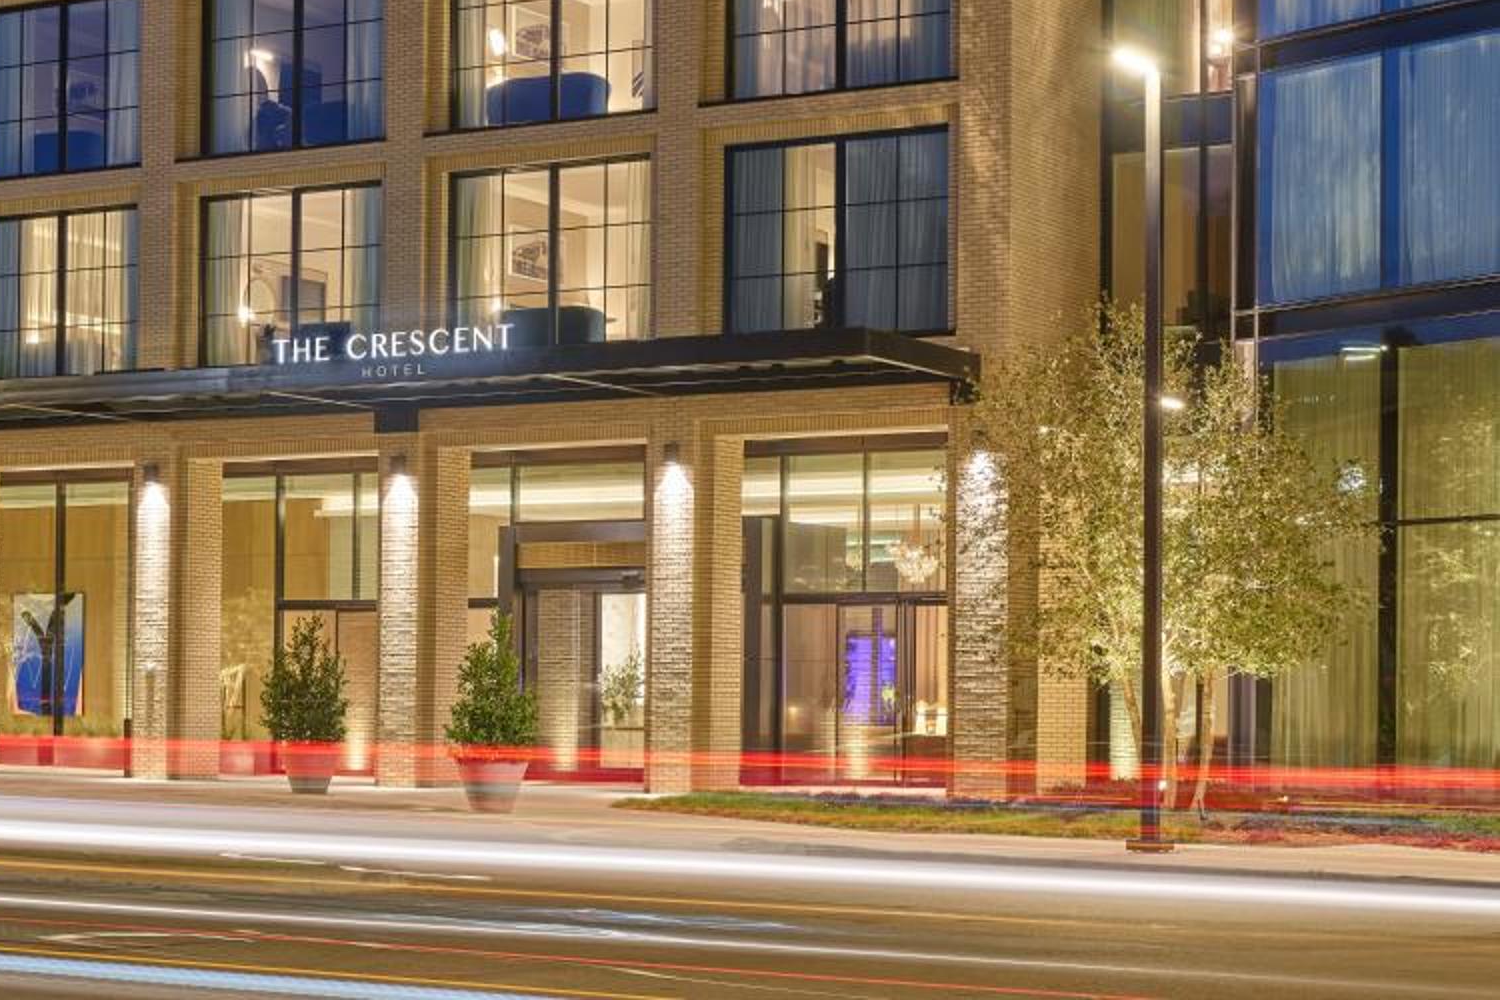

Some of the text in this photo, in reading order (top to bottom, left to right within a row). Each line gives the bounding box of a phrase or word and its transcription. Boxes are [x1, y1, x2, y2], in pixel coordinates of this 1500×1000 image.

[272, 323, 514, 363] THE CRESCENT
[361, 364, 426, 377] HOTEL
